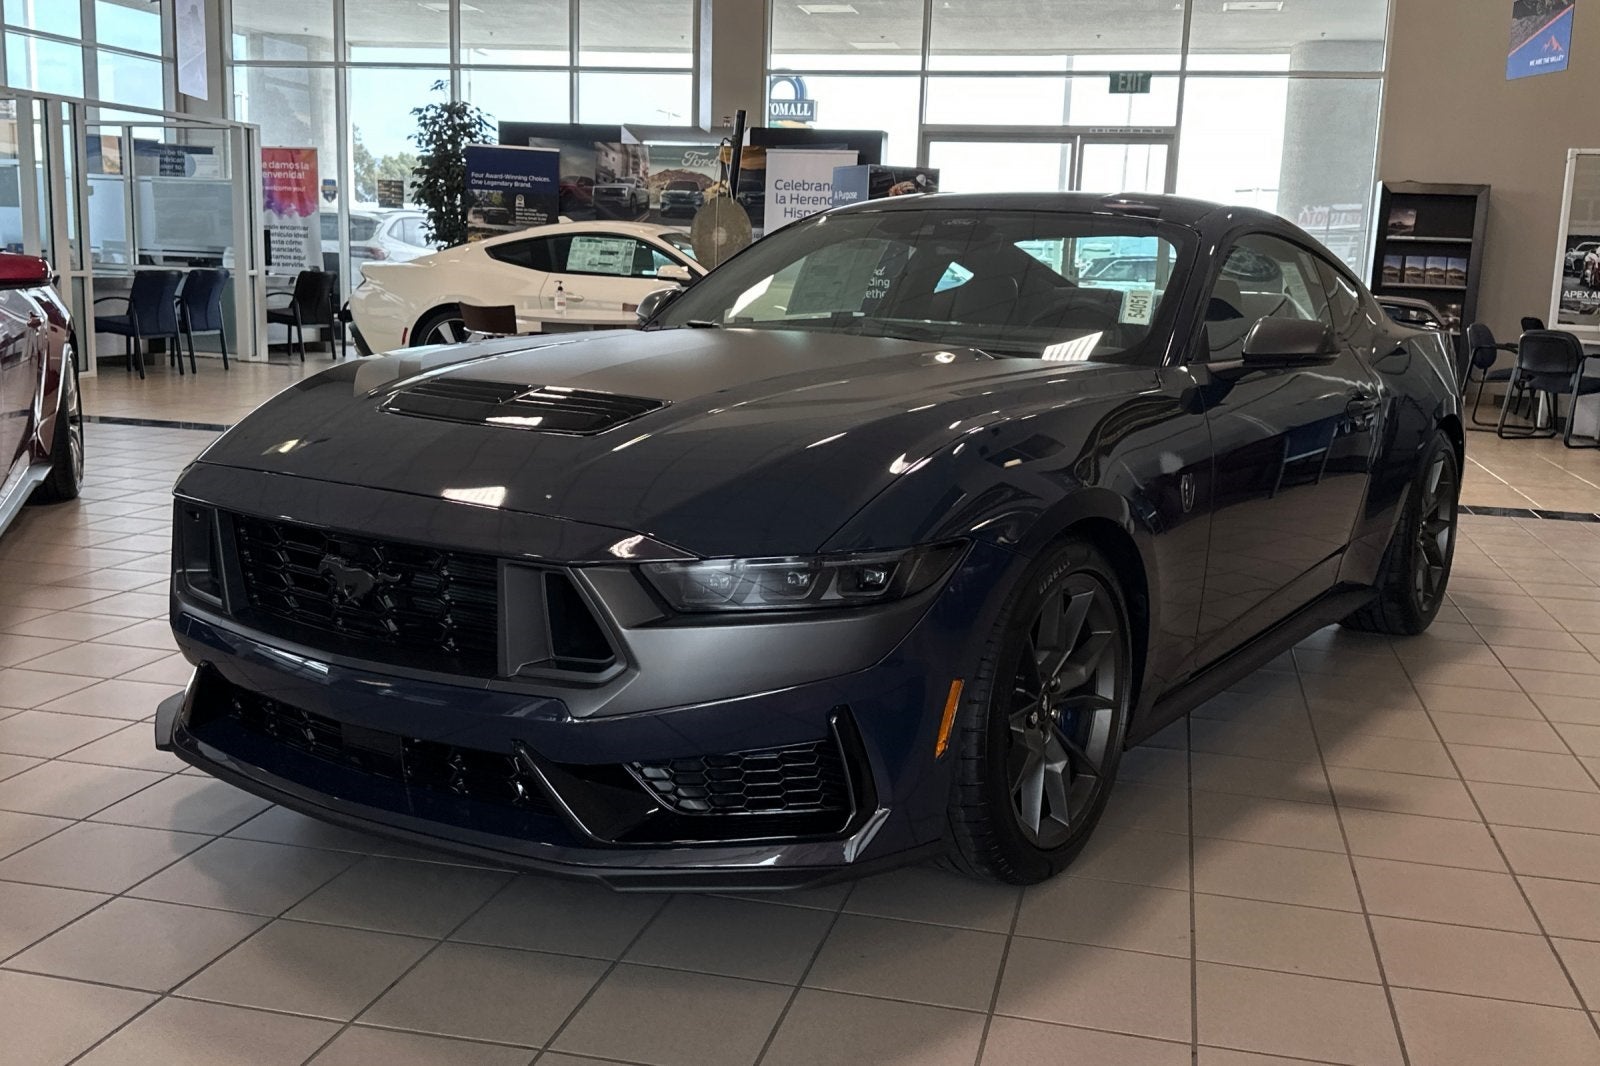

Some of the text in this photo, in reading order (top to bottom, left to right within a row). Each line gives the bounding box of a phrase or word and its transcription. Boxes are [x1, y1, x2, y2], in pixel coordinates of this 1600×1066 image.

[1117, 73, 1144, 92] EXIT
[770, 103, 811, 116] OMALL
[682, 151, 720, 167] Ford
[268, 160, 300, 170] damos
[300, 162, 309, 170] la
[485, 172, 528, 182] Award-Winning
[528, 174, 551, 182] Choices.
[484, 179, 513, 188] Legendary
[775, 179, 832, 191] Celebran
[776, 193, 785, 204] la
[834, 191, 858, 201] A Purpose
[1563, 290, 1590, 299] APEX
[1128, 295, 1148, 319] 54051
